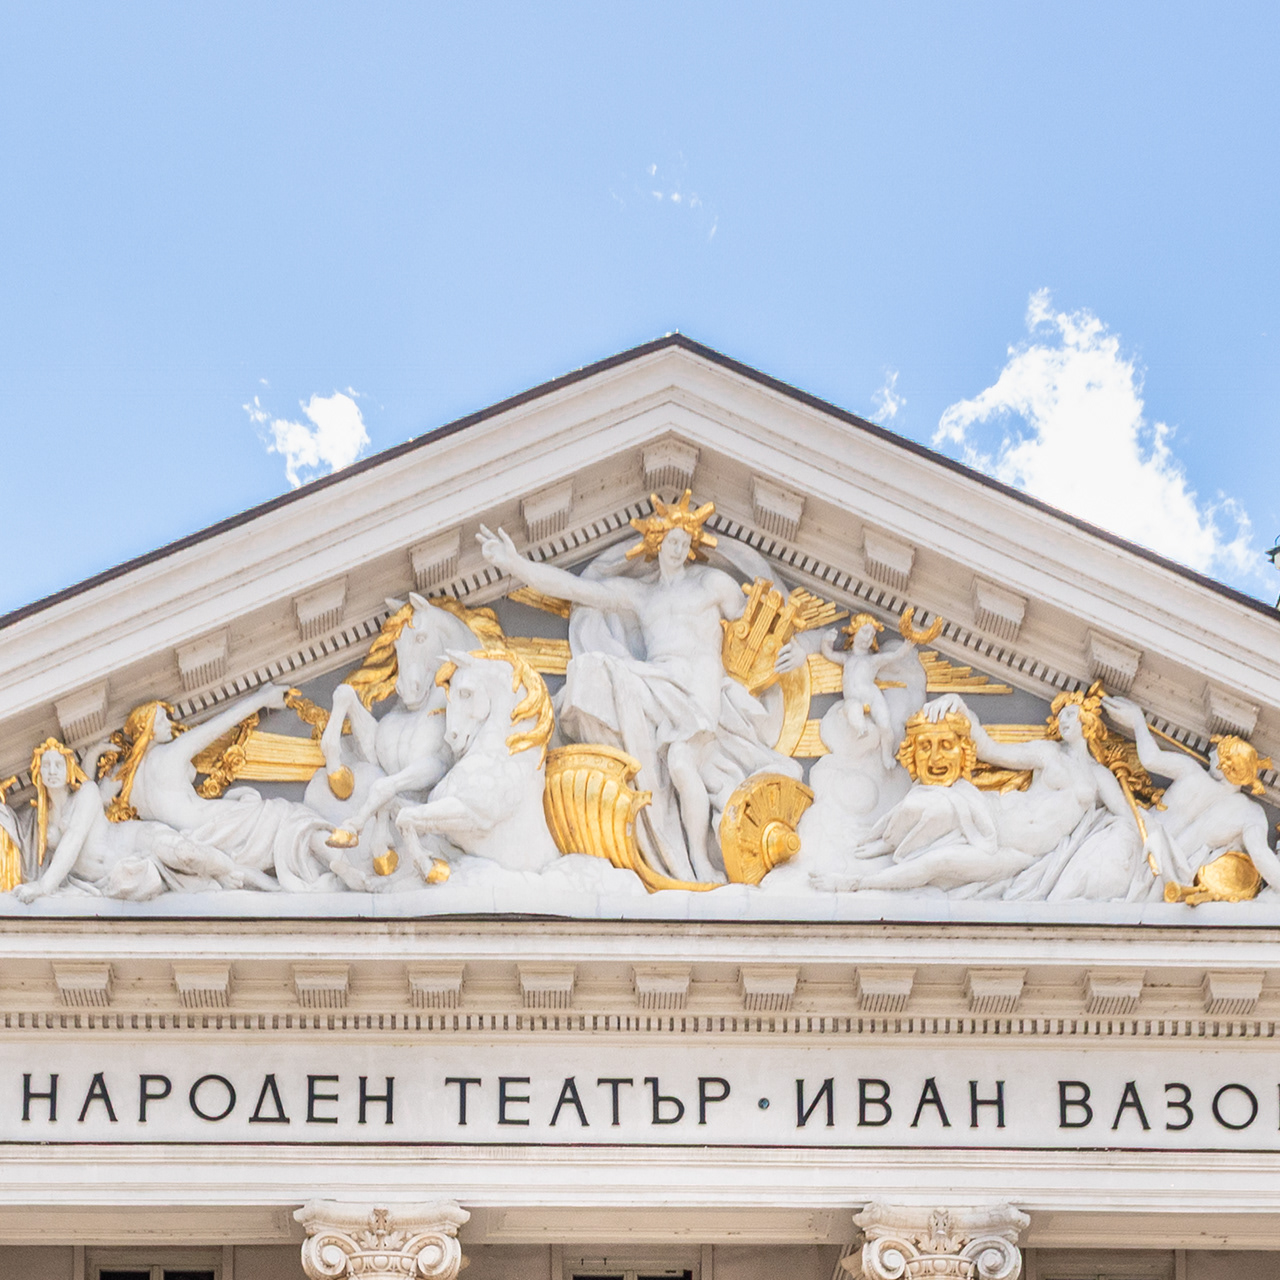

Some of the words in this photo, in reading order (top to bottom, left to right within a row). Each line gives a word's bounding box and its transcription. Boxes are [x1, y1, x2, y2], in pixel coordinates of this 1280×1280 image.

[21, 1071, 395, 1125] НАРОДЕН
[444, 1076, 732, 1127] ТЕАТЪР
[795, 1076, 1007, 1129] ИВАН
